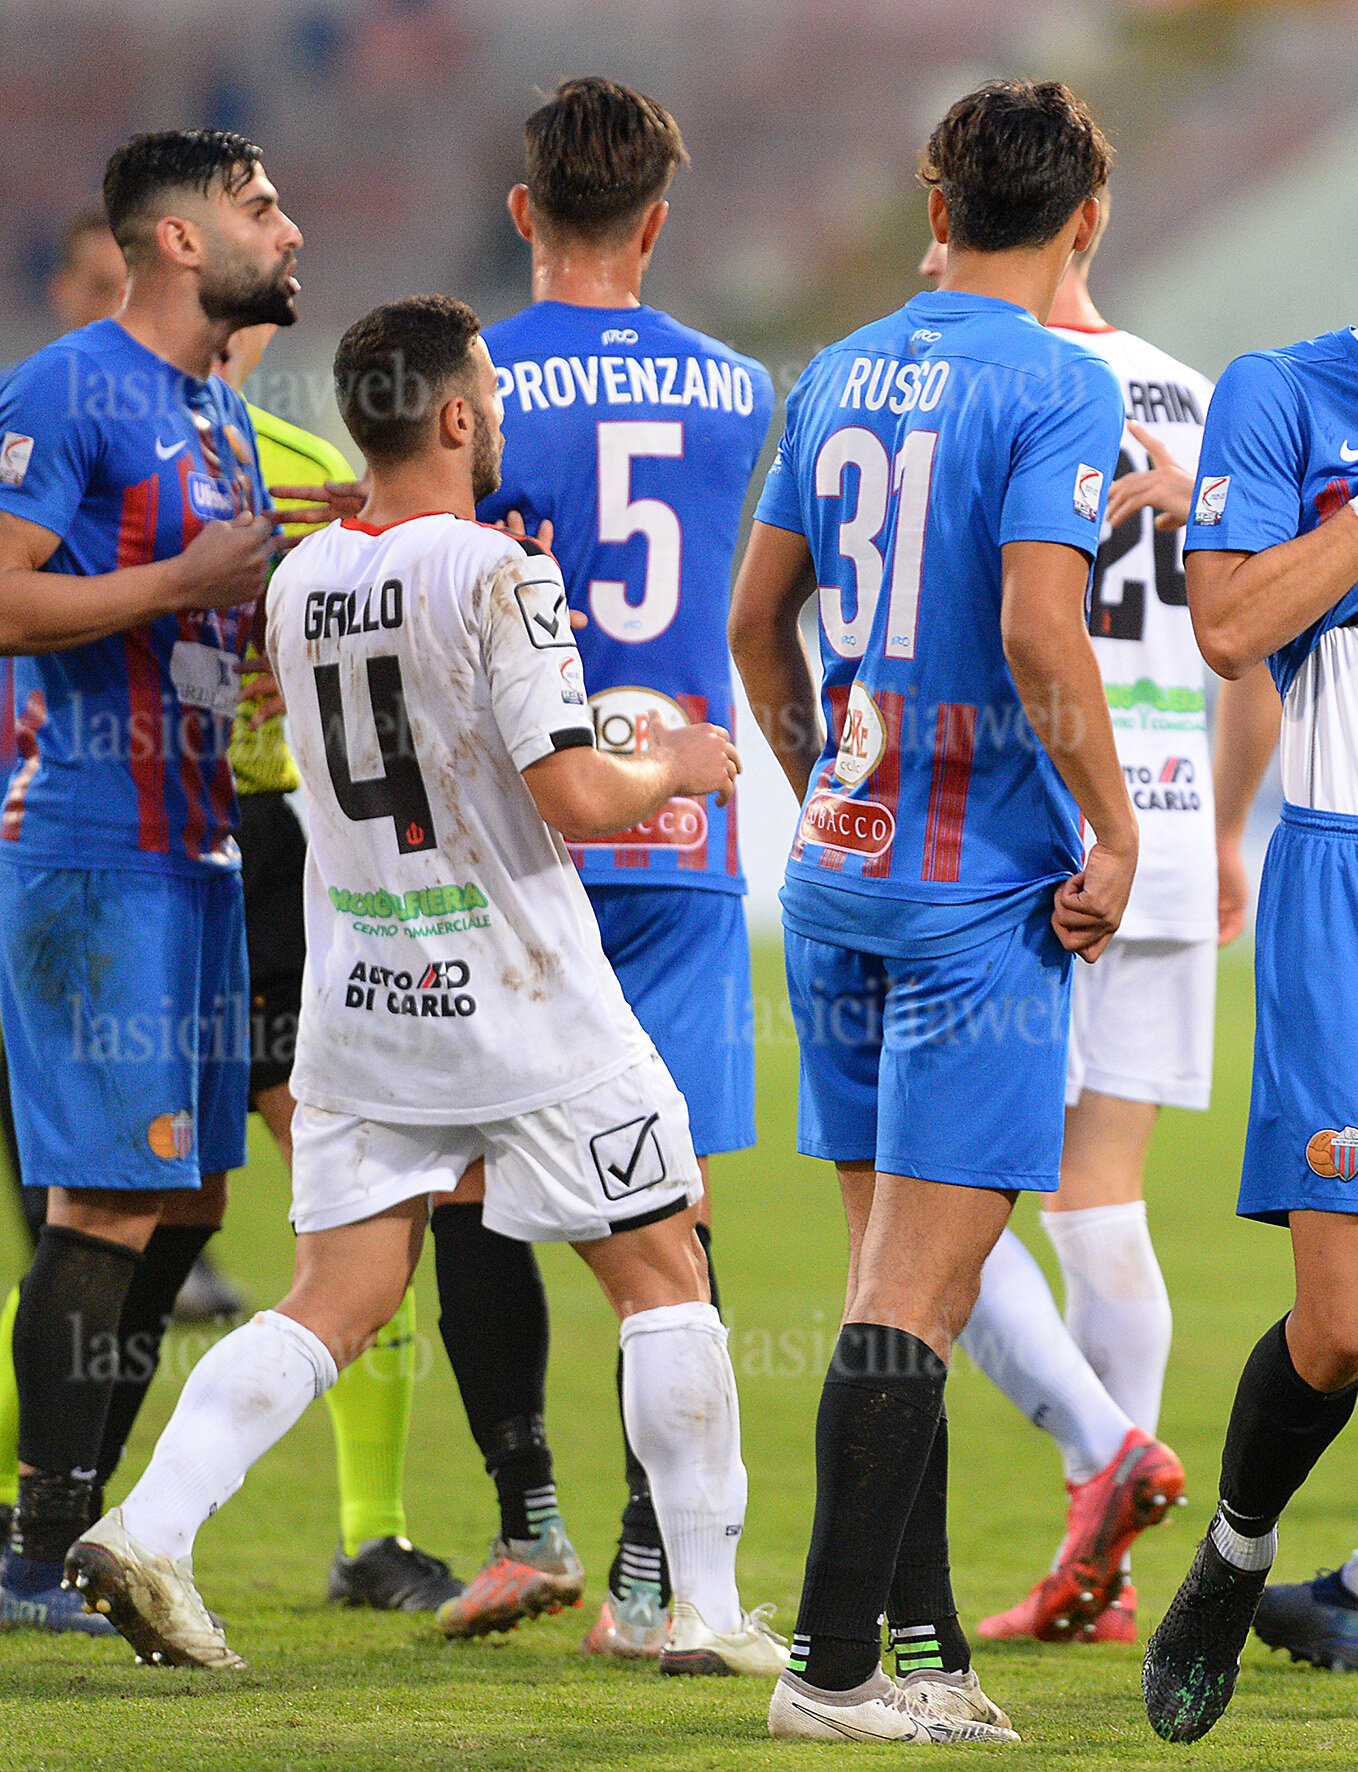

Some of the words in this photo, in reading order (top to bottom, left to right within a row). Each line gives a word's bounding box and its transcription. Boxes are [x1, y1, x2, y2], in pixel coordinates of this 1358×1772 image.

[494, 355, 754, 420] PROVENZANO
[839, 356, 951, 415] RUSSO
[589, 420, 684, 644] 5
[816, 425, 939, 661] 31
[304, 578, 404, 641] GALLO
[312, 654, 438, 855] 4
[344, 983, 377, 1011] DI
[386, 991, 477, 1017] CARLO
[348, 960, 413, 991] AUTO
